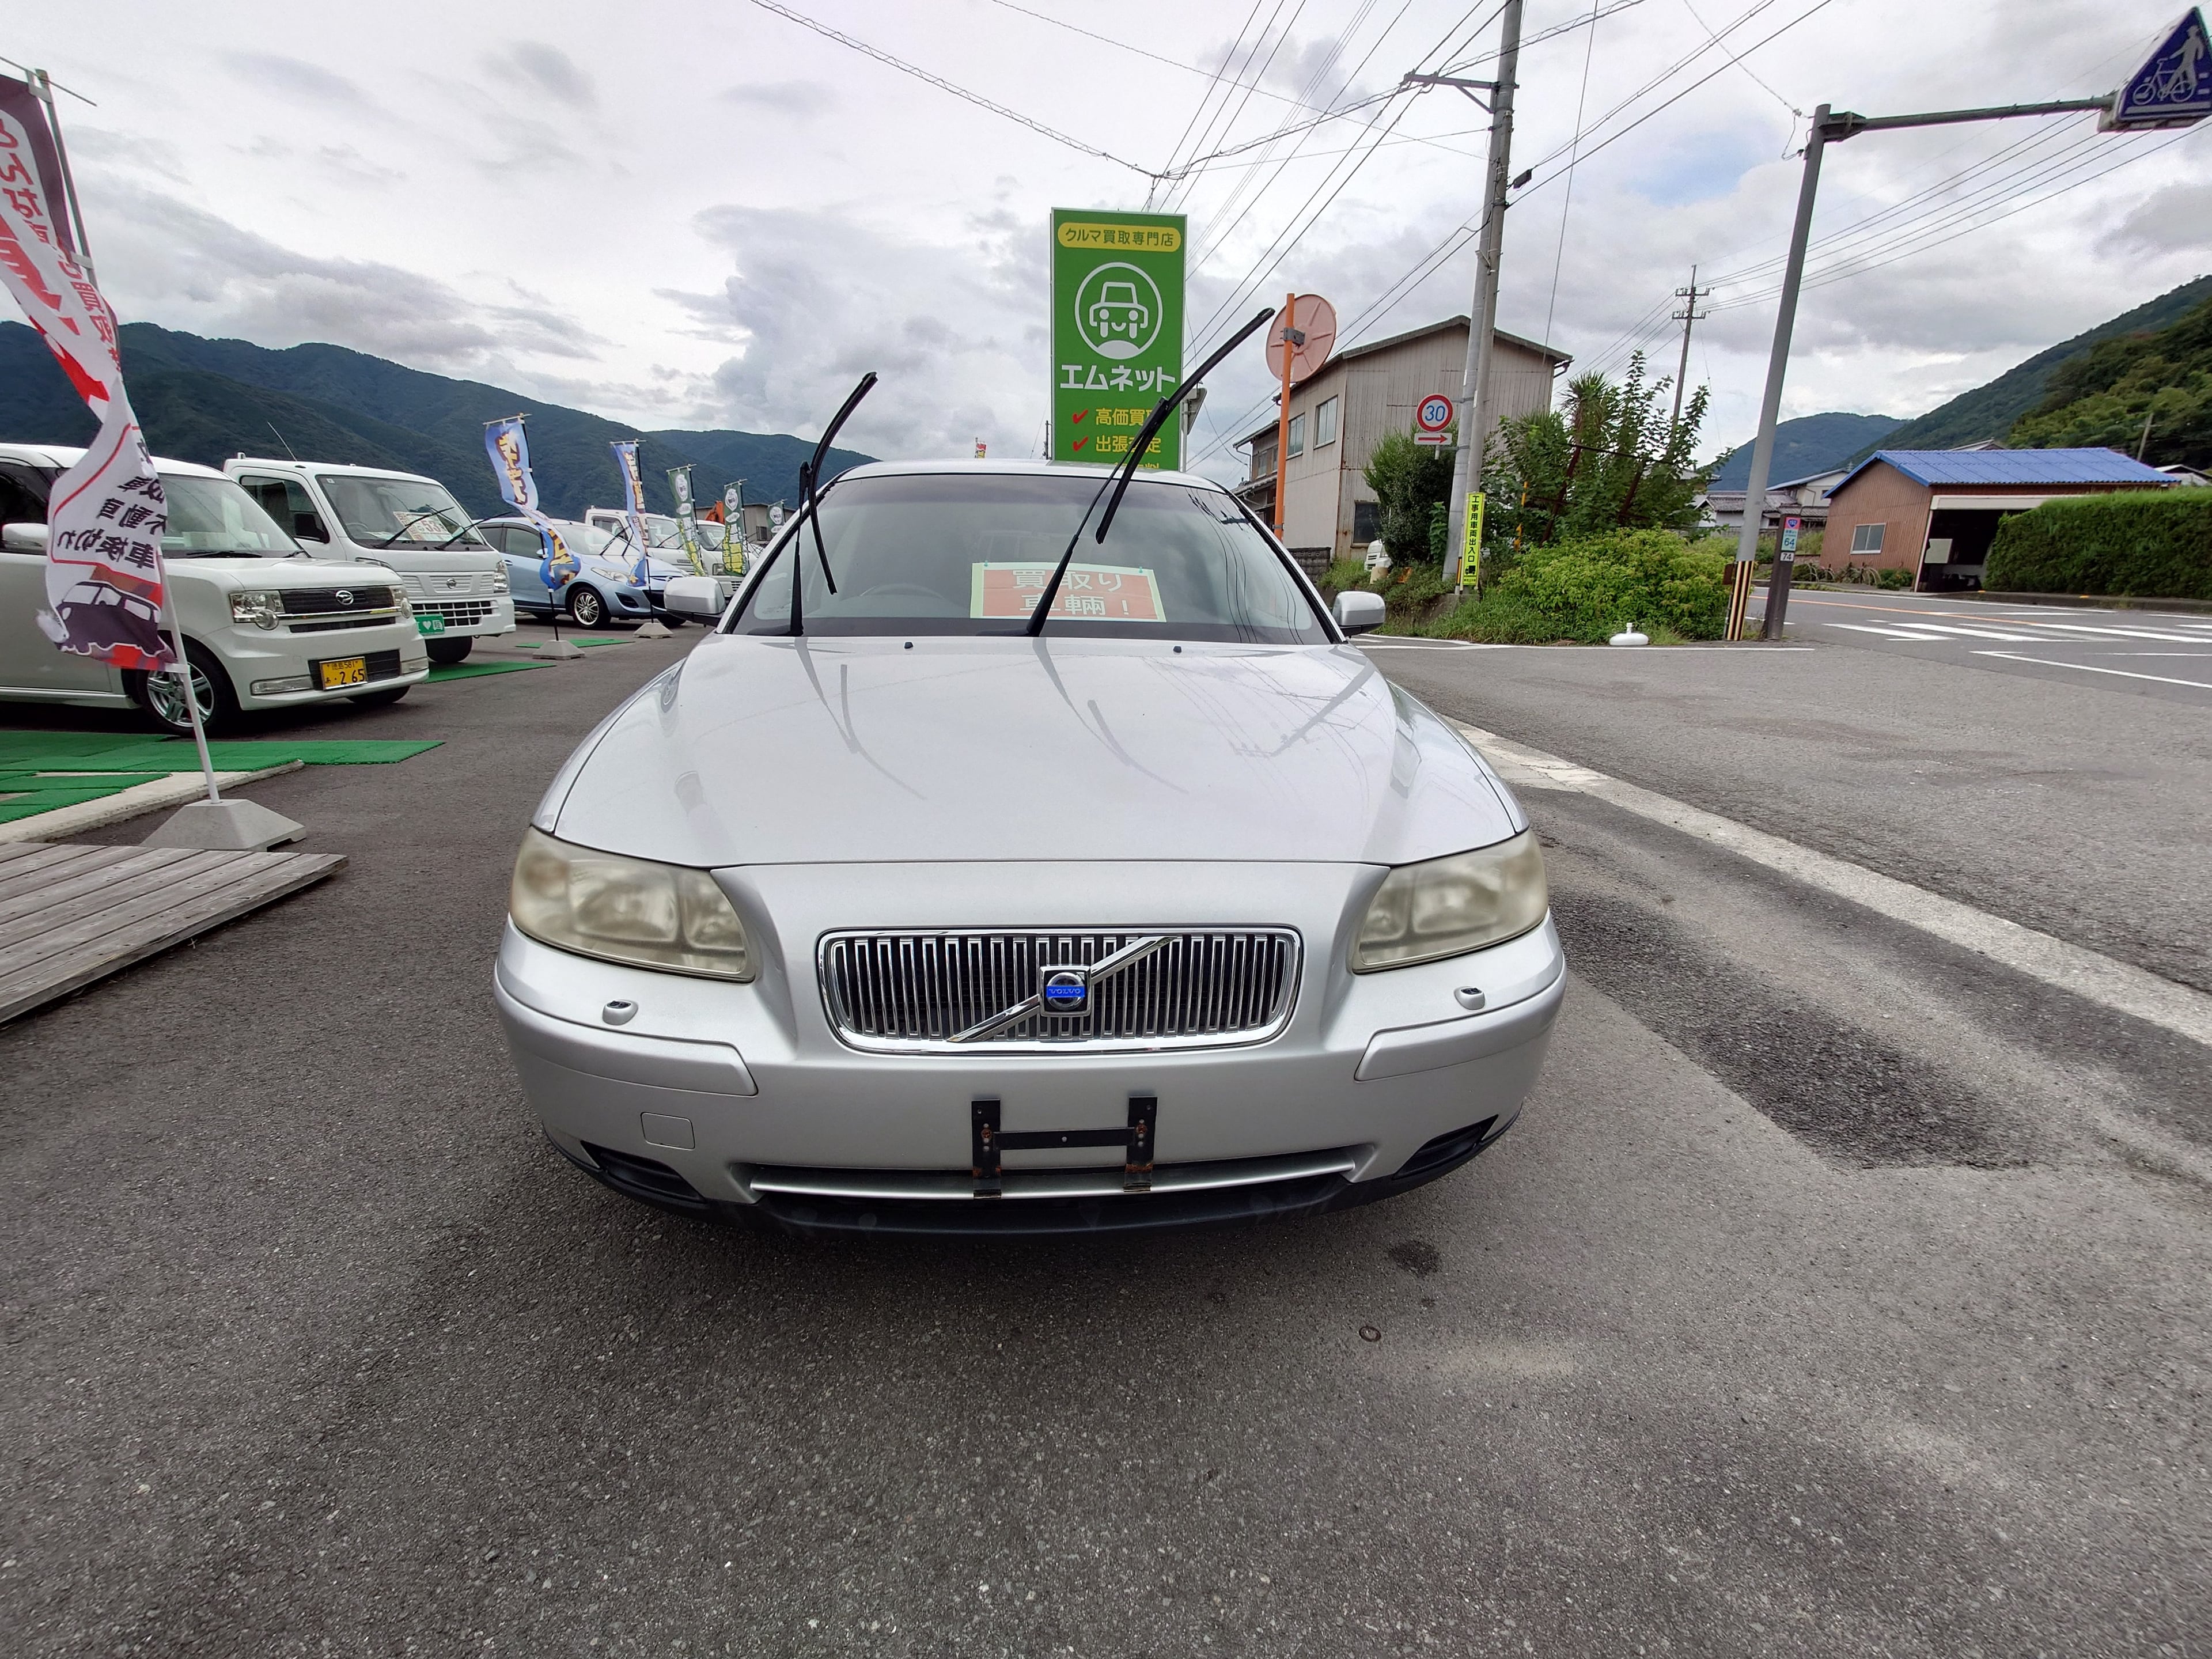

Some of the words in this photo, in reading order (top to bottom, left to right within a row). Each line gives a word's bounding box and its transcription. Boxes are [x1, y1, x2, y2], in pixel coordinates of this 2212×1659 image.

[1065, 228, 1174, 247] クルマ買取専門店
[1060, 365, 1176, 392] エムネット
[1096, 408, 1152, 426] 高価買
[1425, 404, 1446, 422] 30
[1468, 495, 1480, 562] 工事用車両出入口
[1784, 537, 1795, 546] 64
[1012, 570, 1122, 592] 買取り
